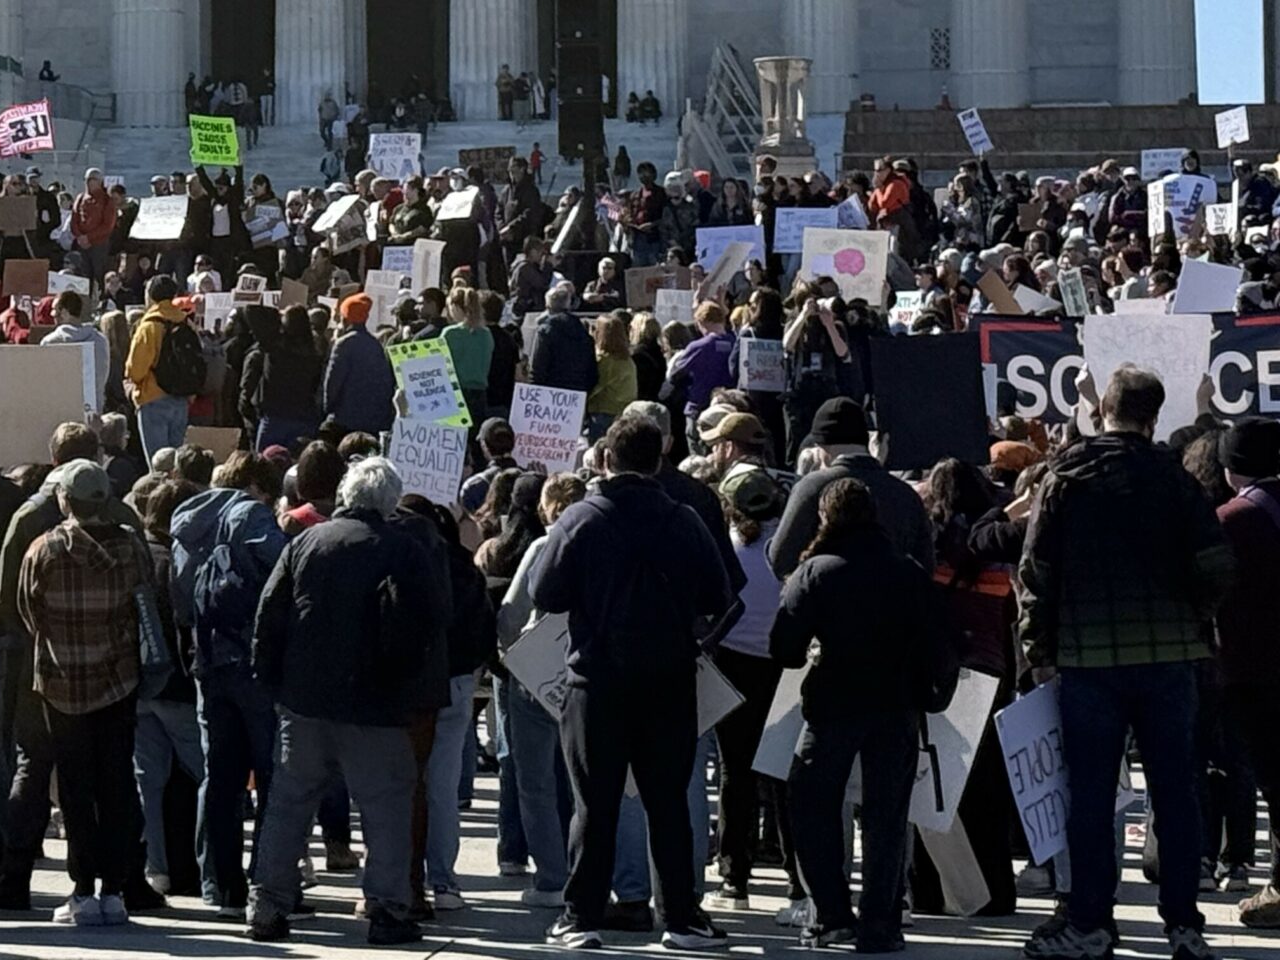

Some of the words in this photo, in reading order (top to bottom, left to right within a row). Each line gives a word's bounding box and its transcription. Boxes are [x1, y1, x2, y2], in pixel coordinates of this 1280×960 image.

[408, 368, 443, 383] SCIENCE
[519, 387, 542, 403] USE
[548, 389, 580, 408] YOUR
[400, 422, 466, 452] WOMEN
[529, 421, 562, 435] FUND
